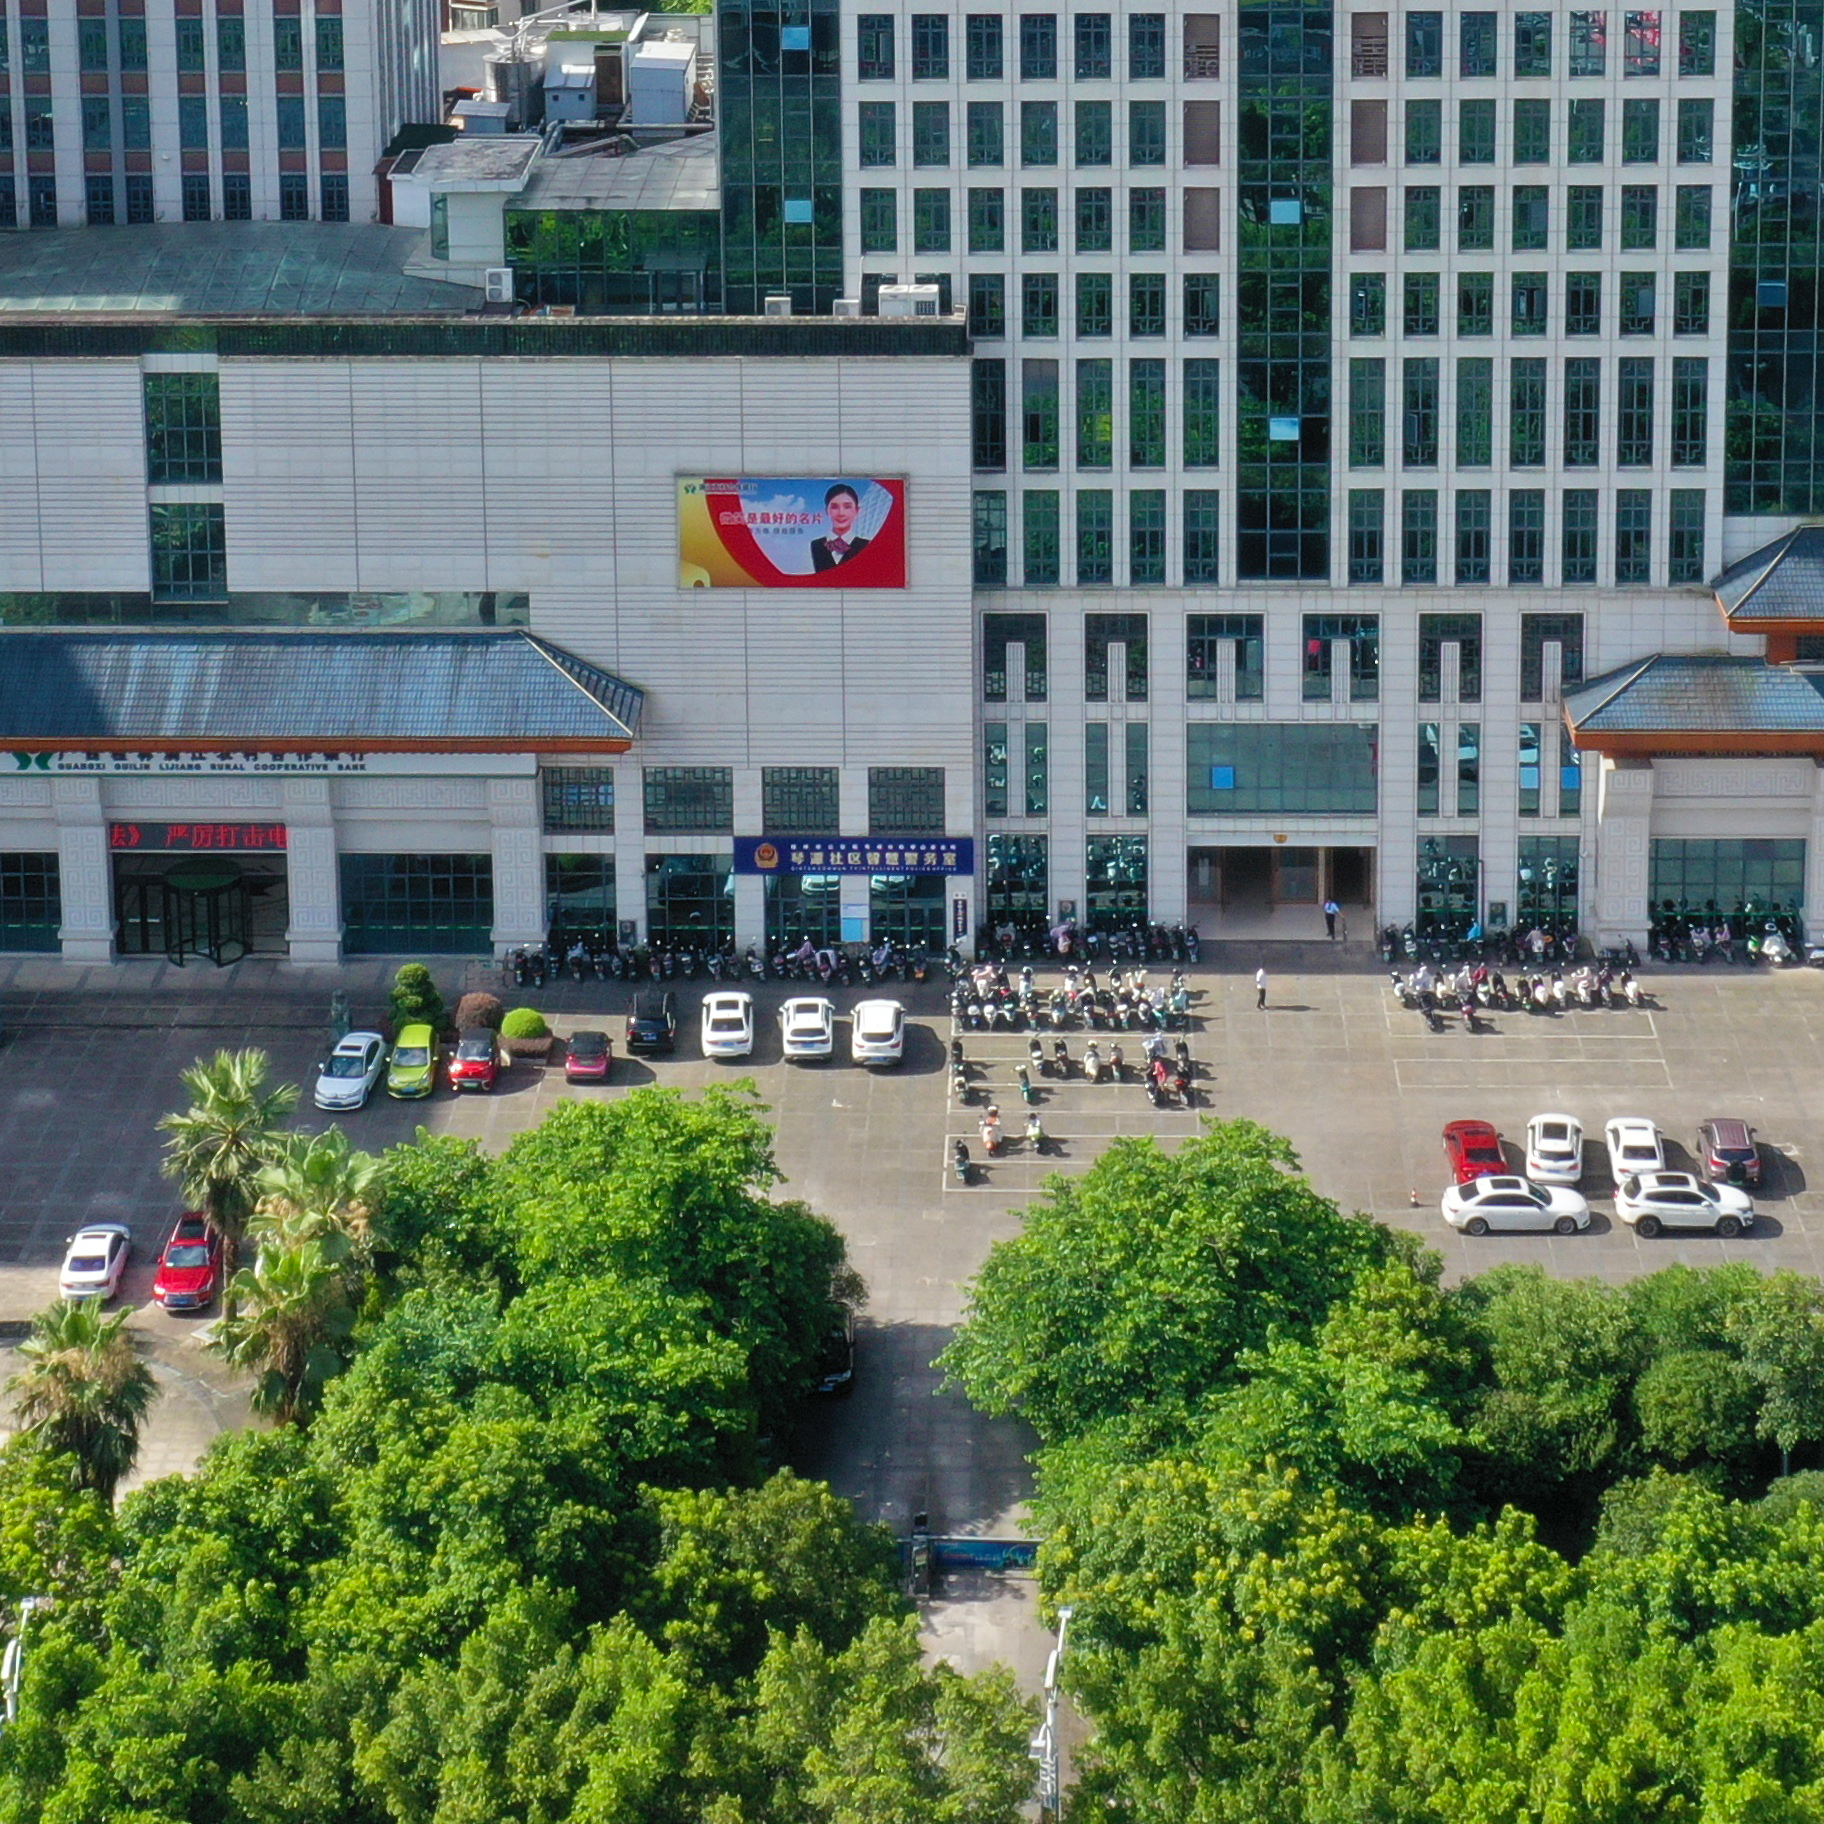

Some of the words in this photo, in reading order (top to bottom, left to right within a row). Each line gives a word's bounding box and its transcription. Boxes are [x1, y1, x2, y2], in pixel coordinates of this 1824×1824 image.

[57, 762, 107, 771] GUANGXI
[114, 762, 151, 771] GUILIN
[210, 762, 245, 771] RURAL
[254, 762, 328, 771] COOPERATIVE
[337, 762, 367, 771] BANK
